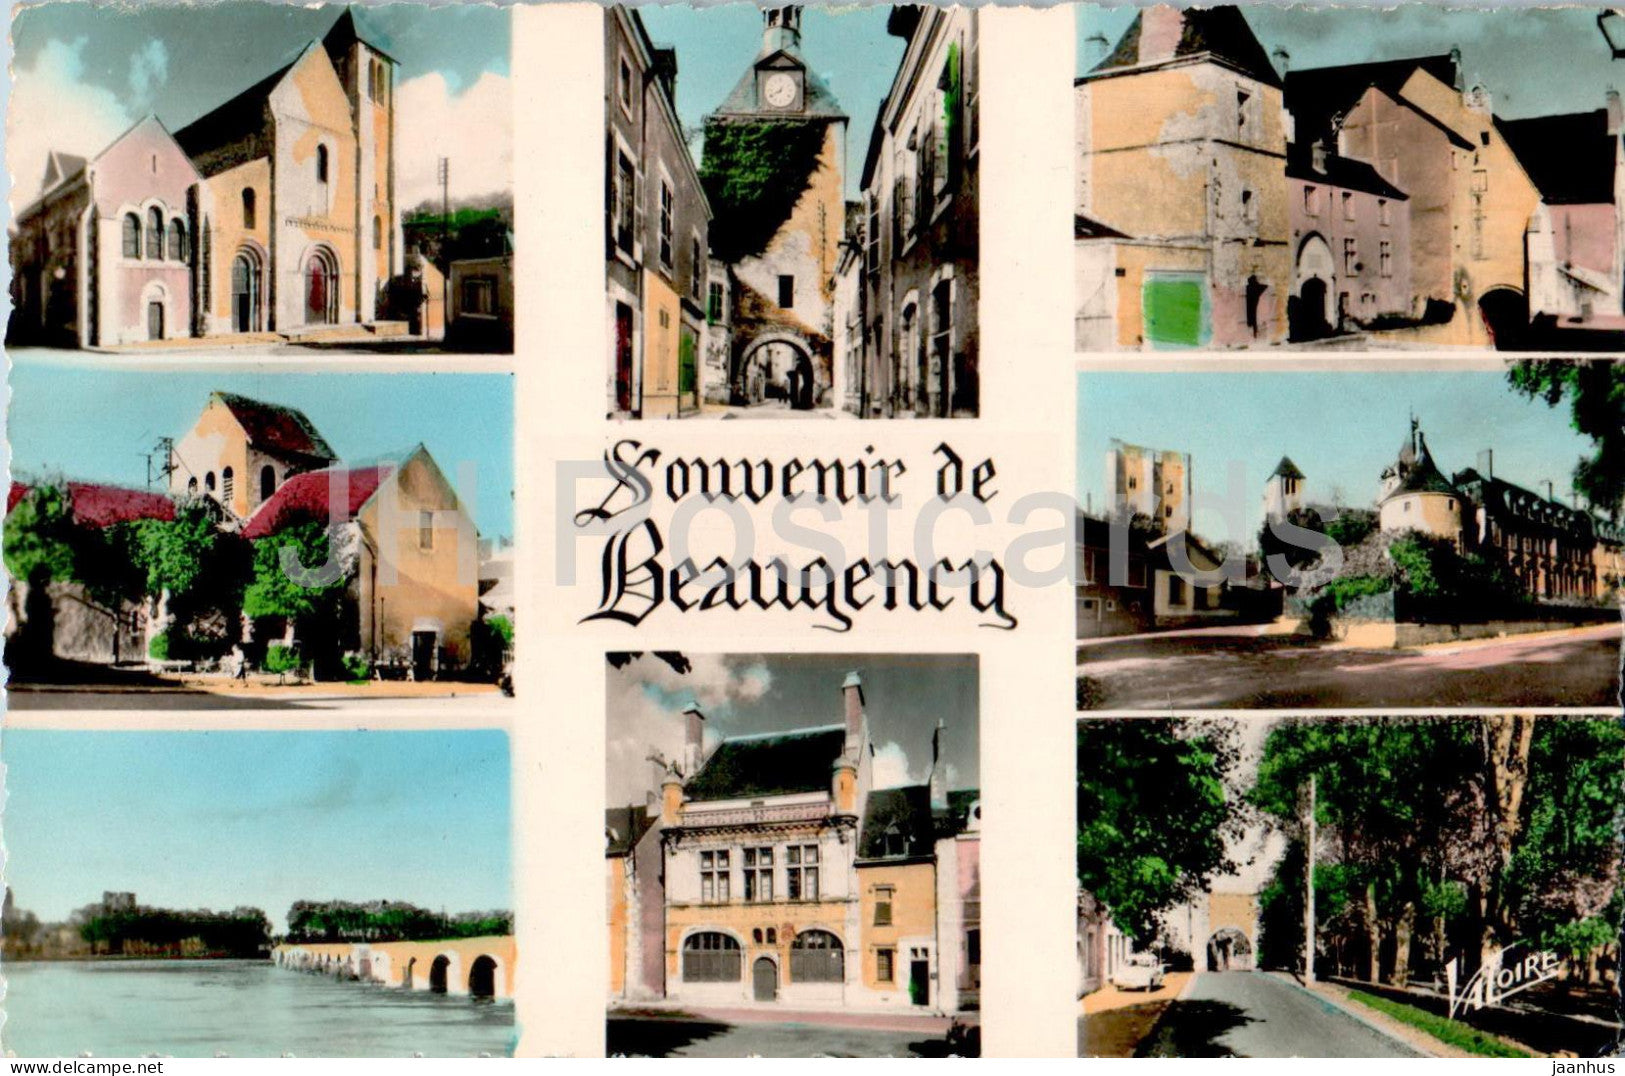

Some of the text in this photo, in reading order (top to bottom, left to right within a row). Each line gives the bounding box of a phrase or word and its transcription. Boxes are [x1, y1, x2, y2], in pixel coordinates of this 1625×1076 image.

[574, 439, 999, 527] Souvenir de
[577, 518, 1017, 632] Beaugency
